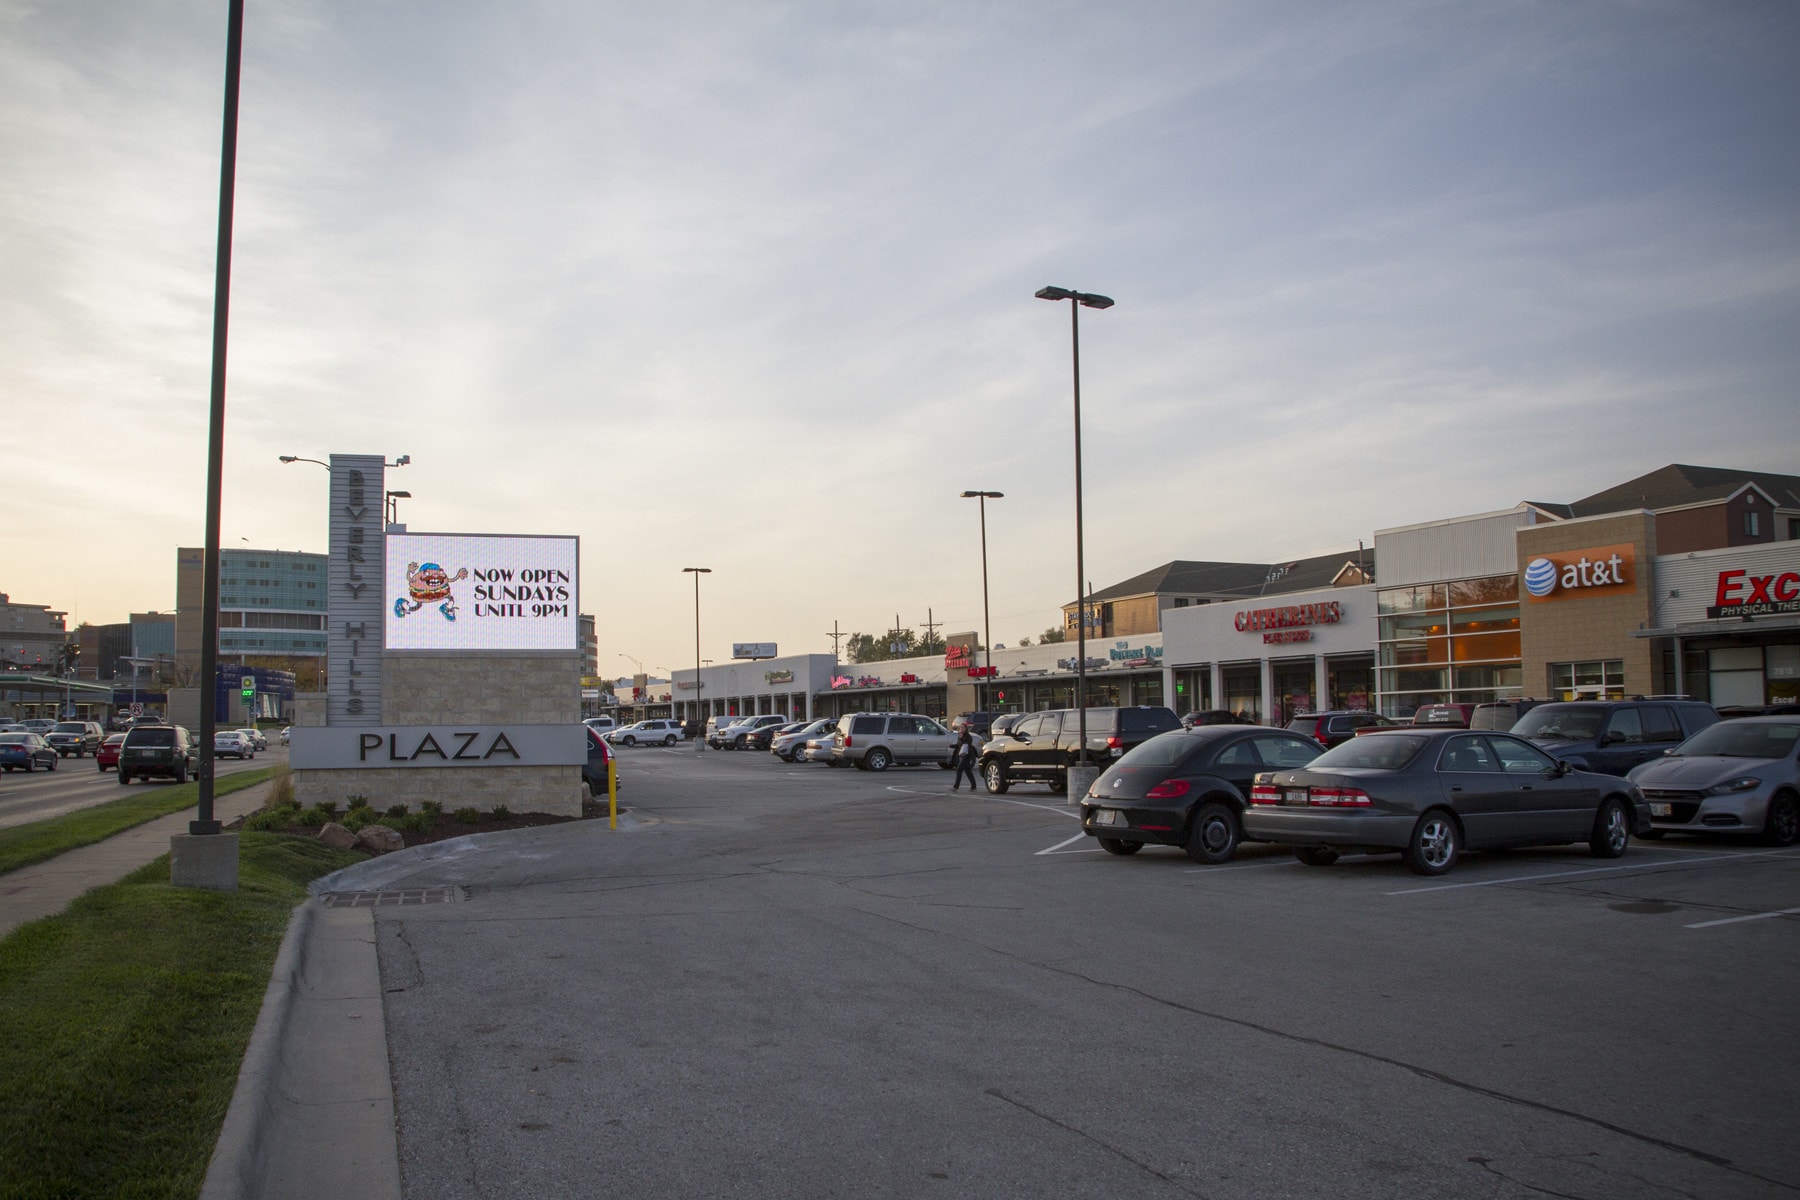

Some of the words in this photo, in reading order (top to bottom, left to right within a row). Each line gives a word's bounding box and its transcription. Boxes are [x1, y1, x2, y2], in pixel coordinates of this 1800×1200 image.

[345, 470, 367, 600] BEVERLY
[474, 569, 514, 583] NOW
[520, 569, 569, 583] OPEN
[1561, 553, 1624, 588] at&t
[474, 585, 569, 601] SUNDAYS
[474, 603, 527, 617] UNITL
[531, 603, 568, 617] 9PM
[1235, 601, 1340, 632] CATHERINES
[1721, 602, 1774, 616] PHYSICAL
[345, 622, 365, 715] HILLS
[360, 732, 520, 761] PLAZA
